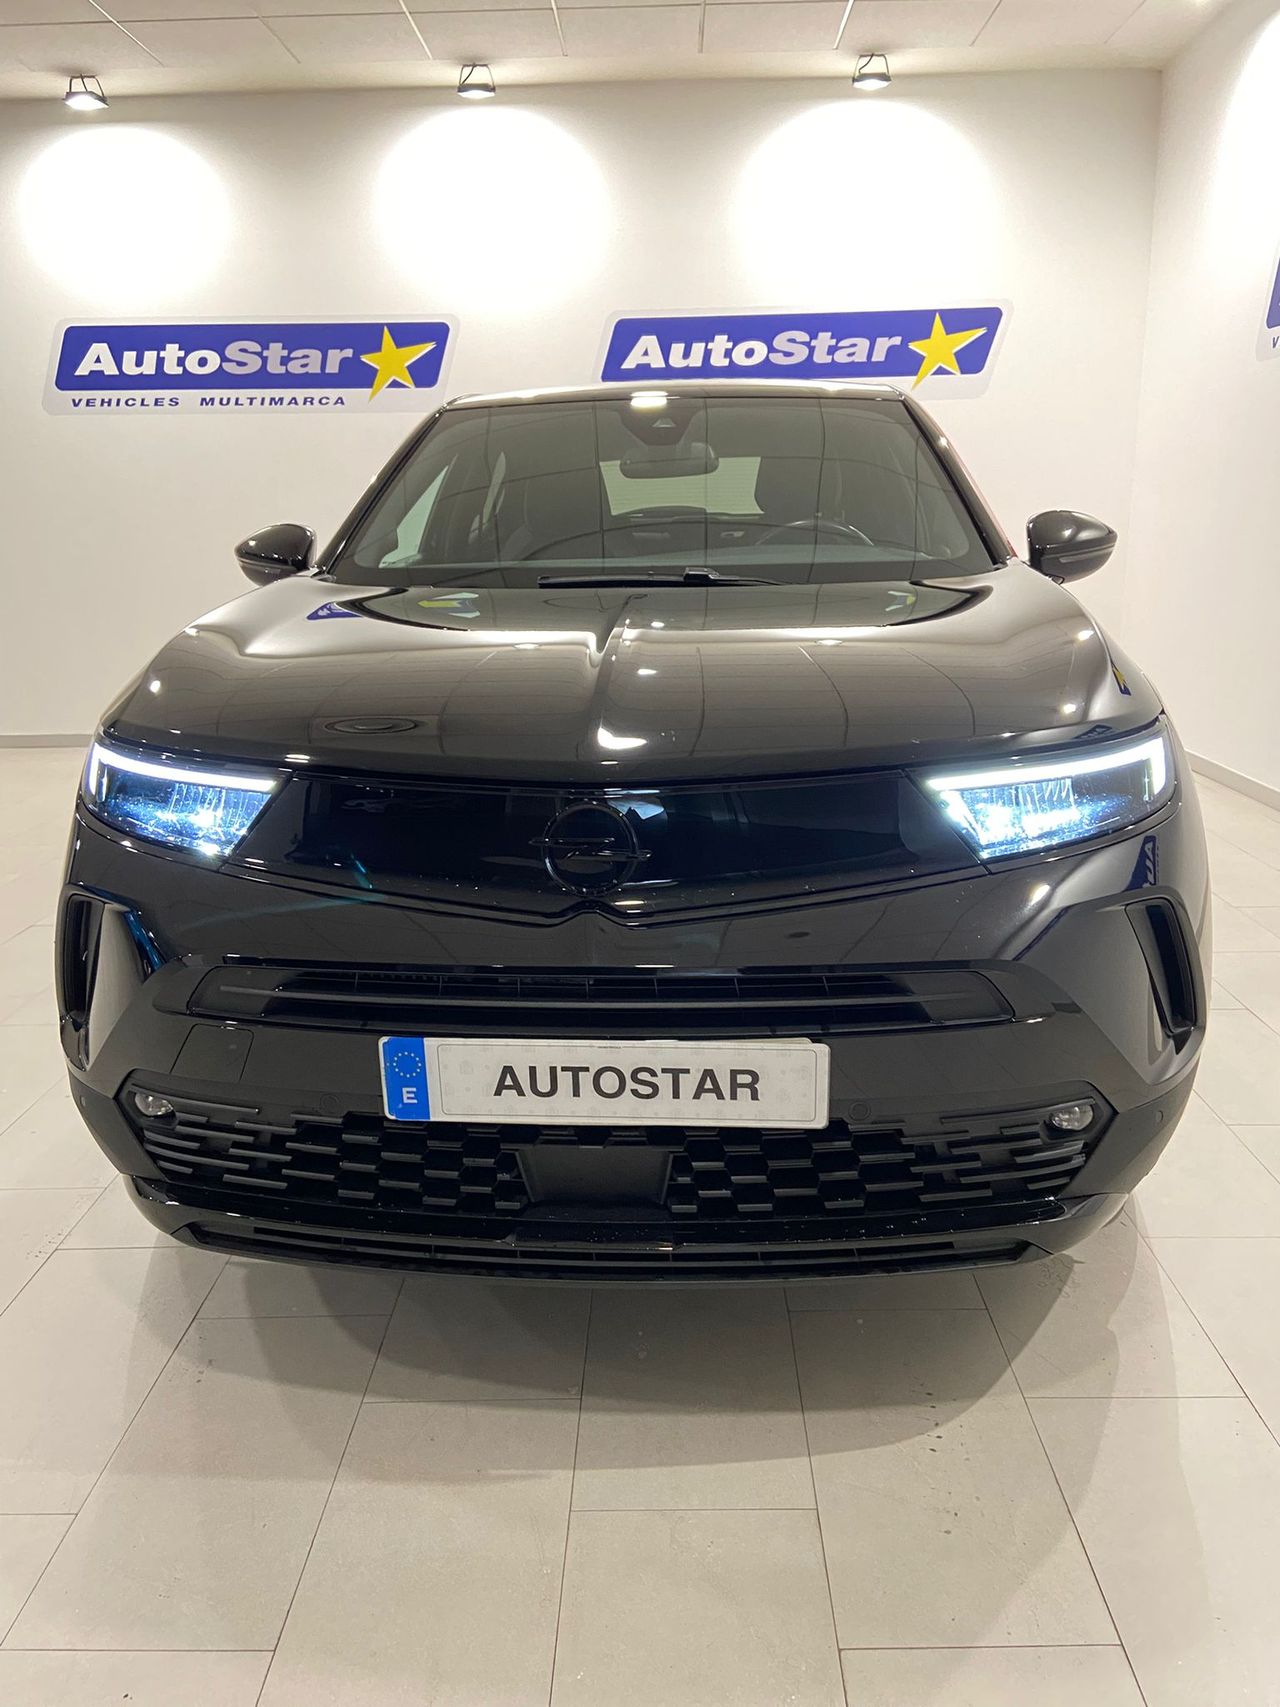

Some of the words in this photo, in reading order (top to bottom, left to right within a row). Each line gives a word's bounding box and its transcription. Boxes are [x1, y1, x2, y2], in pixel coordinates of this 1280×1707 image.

[73, 340, 353, 376] AutoStar
[620, 329, 902, 370] AutoStar
[71, 397, 180, 408] VEHICLES
[199, 396, 345, 407] MULTIMARCA
[402, 1087, 418, 1104] E
[493, 1065, 760, 1102] AUTOSTAR
